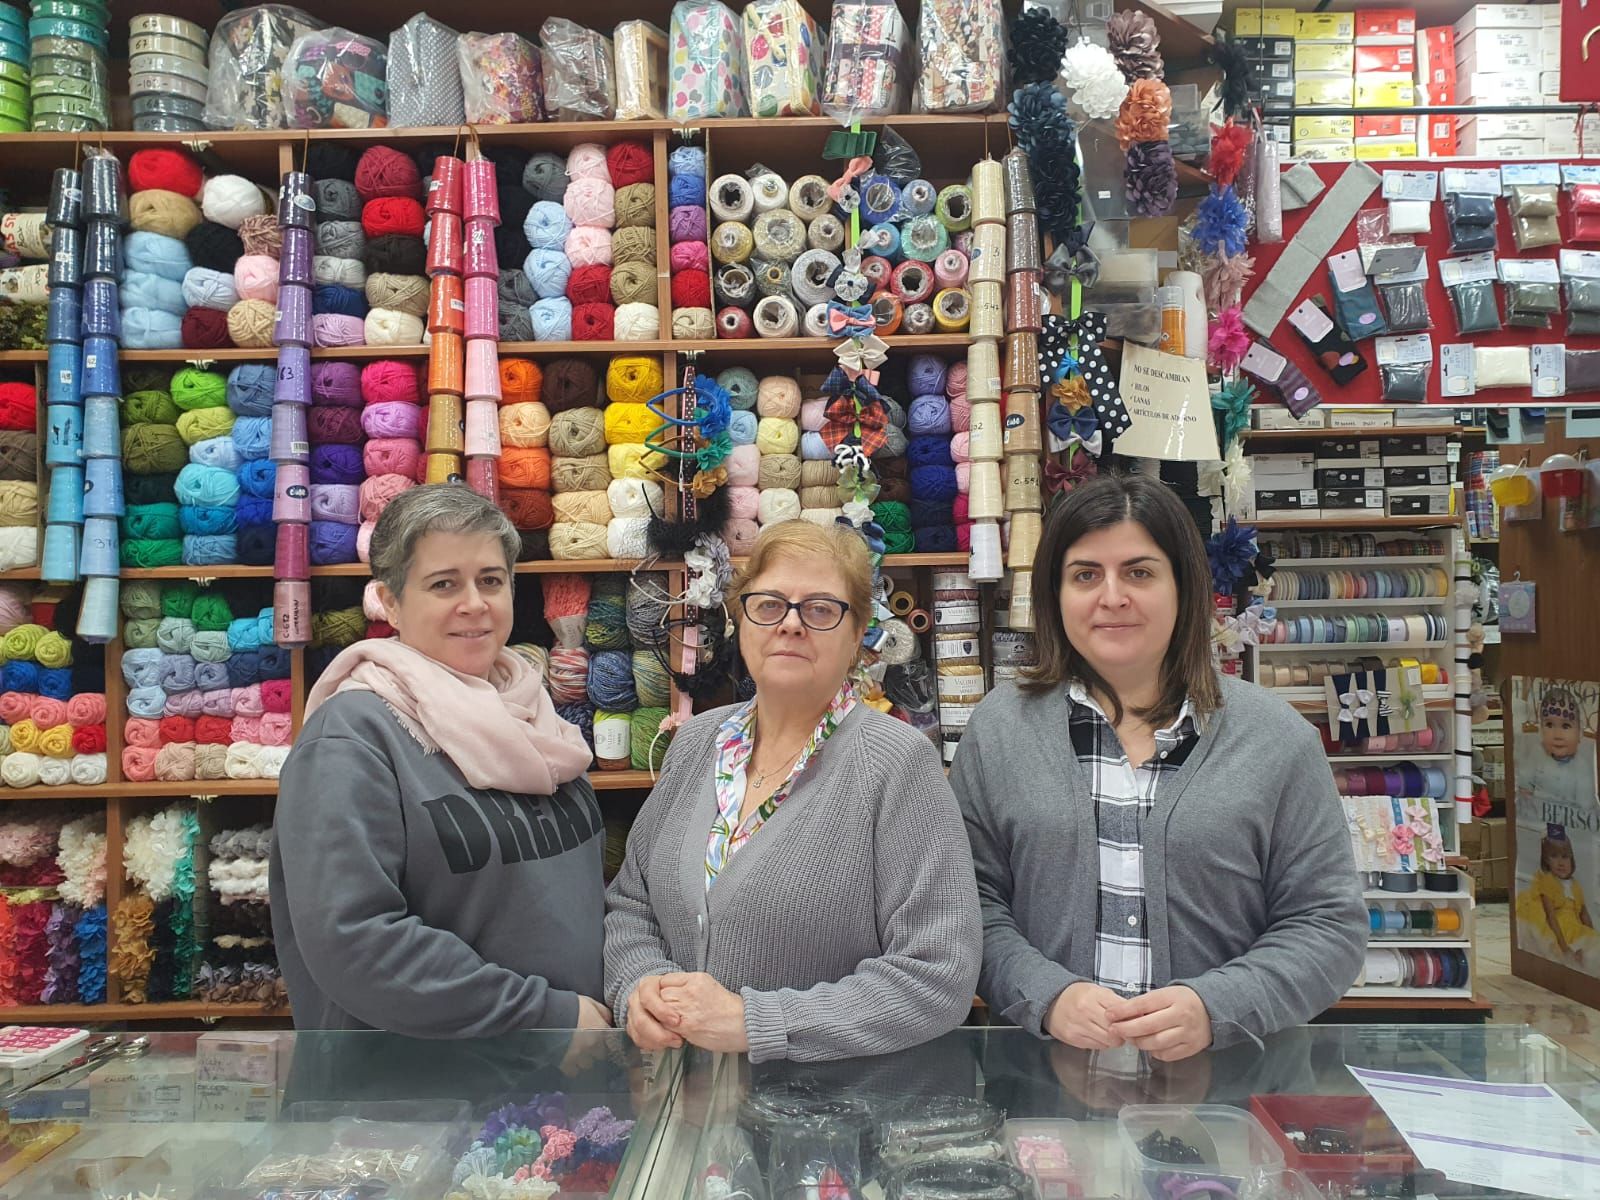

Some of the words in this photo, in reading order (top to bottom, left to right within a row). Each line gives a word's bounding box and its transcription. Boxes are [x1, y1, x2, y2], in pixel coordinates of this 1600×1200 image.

[1134, 364, 1142, 374] NO
[1142, 367, 1150, 376] SE
[1150, 369, 1191, 383] DESCAMBIAN
[1133, 396, 1151, 406] LANAS
